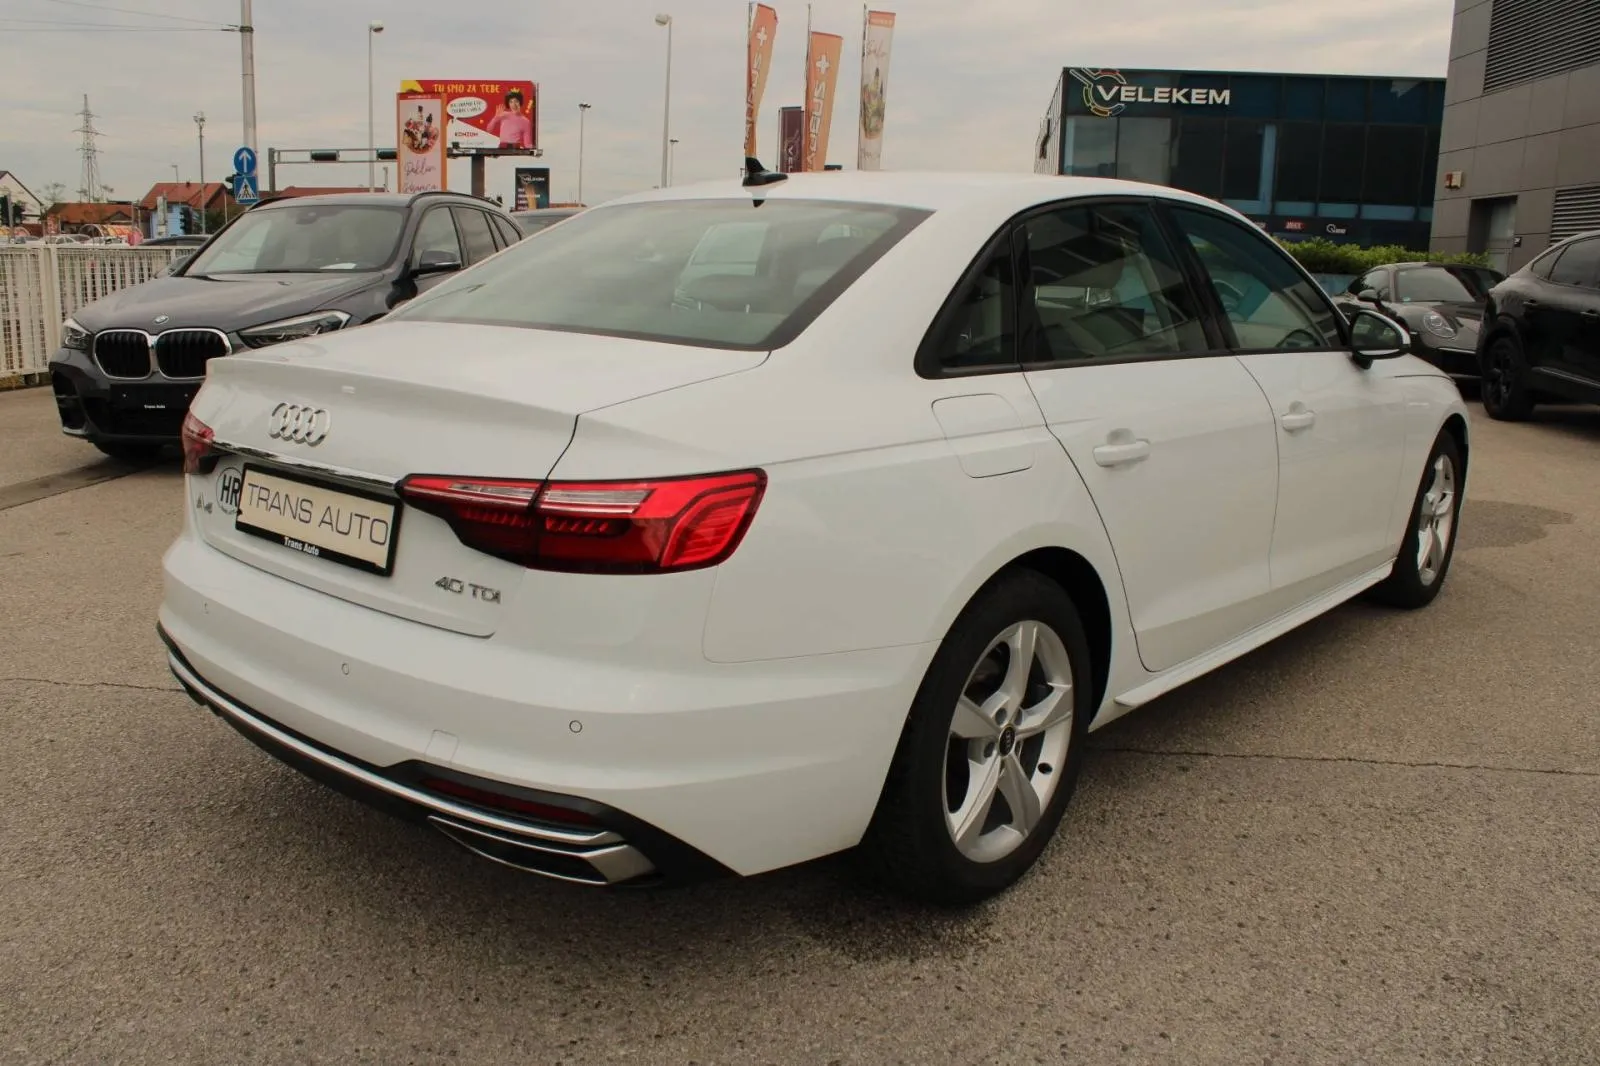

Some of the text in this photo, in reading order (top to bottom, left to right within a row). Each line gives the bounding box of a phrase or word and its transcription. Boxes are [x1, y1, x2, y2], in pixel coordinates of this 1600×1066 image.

[432, 84, 500, 93] TU SMO ZA TEBE
[1096, 85, 1231, 105] VELEKEM
[220, 474, 240, 507] HR
[248, 483, 389, 546] TRANS AUTO
[284, 536, 319, 556] Trans Auto
[435, 576, 501, 605] 40 TDI
